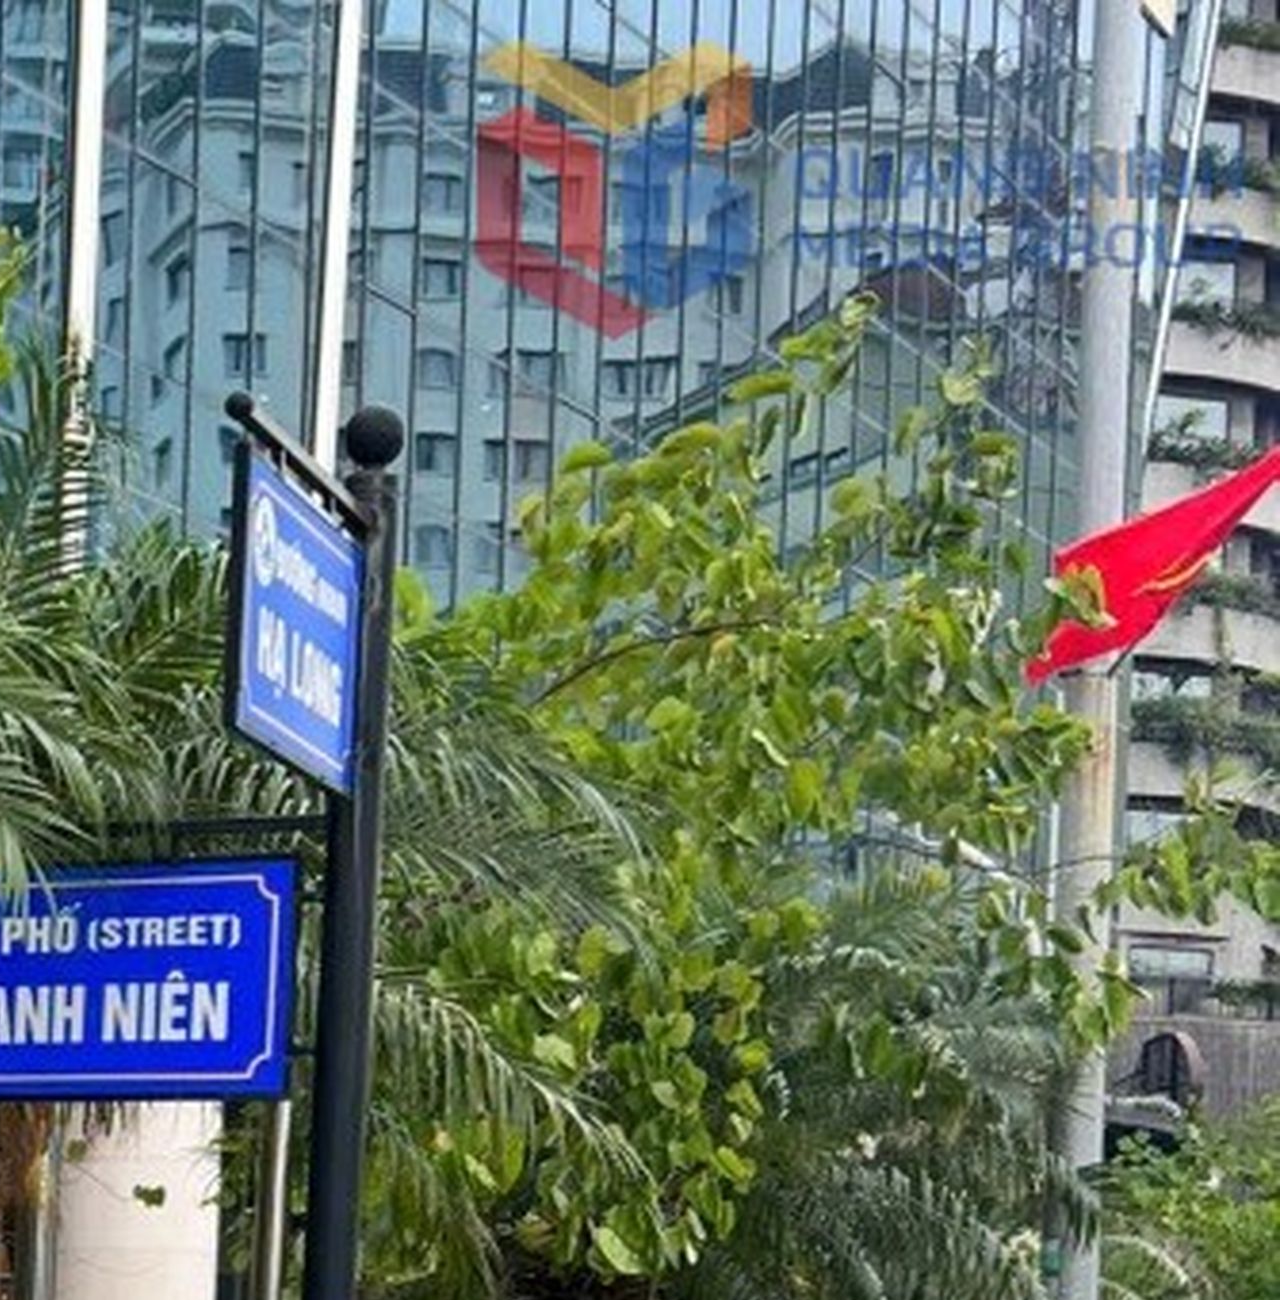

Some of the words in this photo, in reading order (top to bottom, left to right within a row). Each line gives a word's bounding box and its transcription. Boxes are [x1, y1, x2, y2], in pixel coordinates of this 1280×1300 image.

[1, 901, 81, 955] PHỐ
[87, 914, 242, 951] (STREET)
[101, 969, 230, 1044] NIÊN
